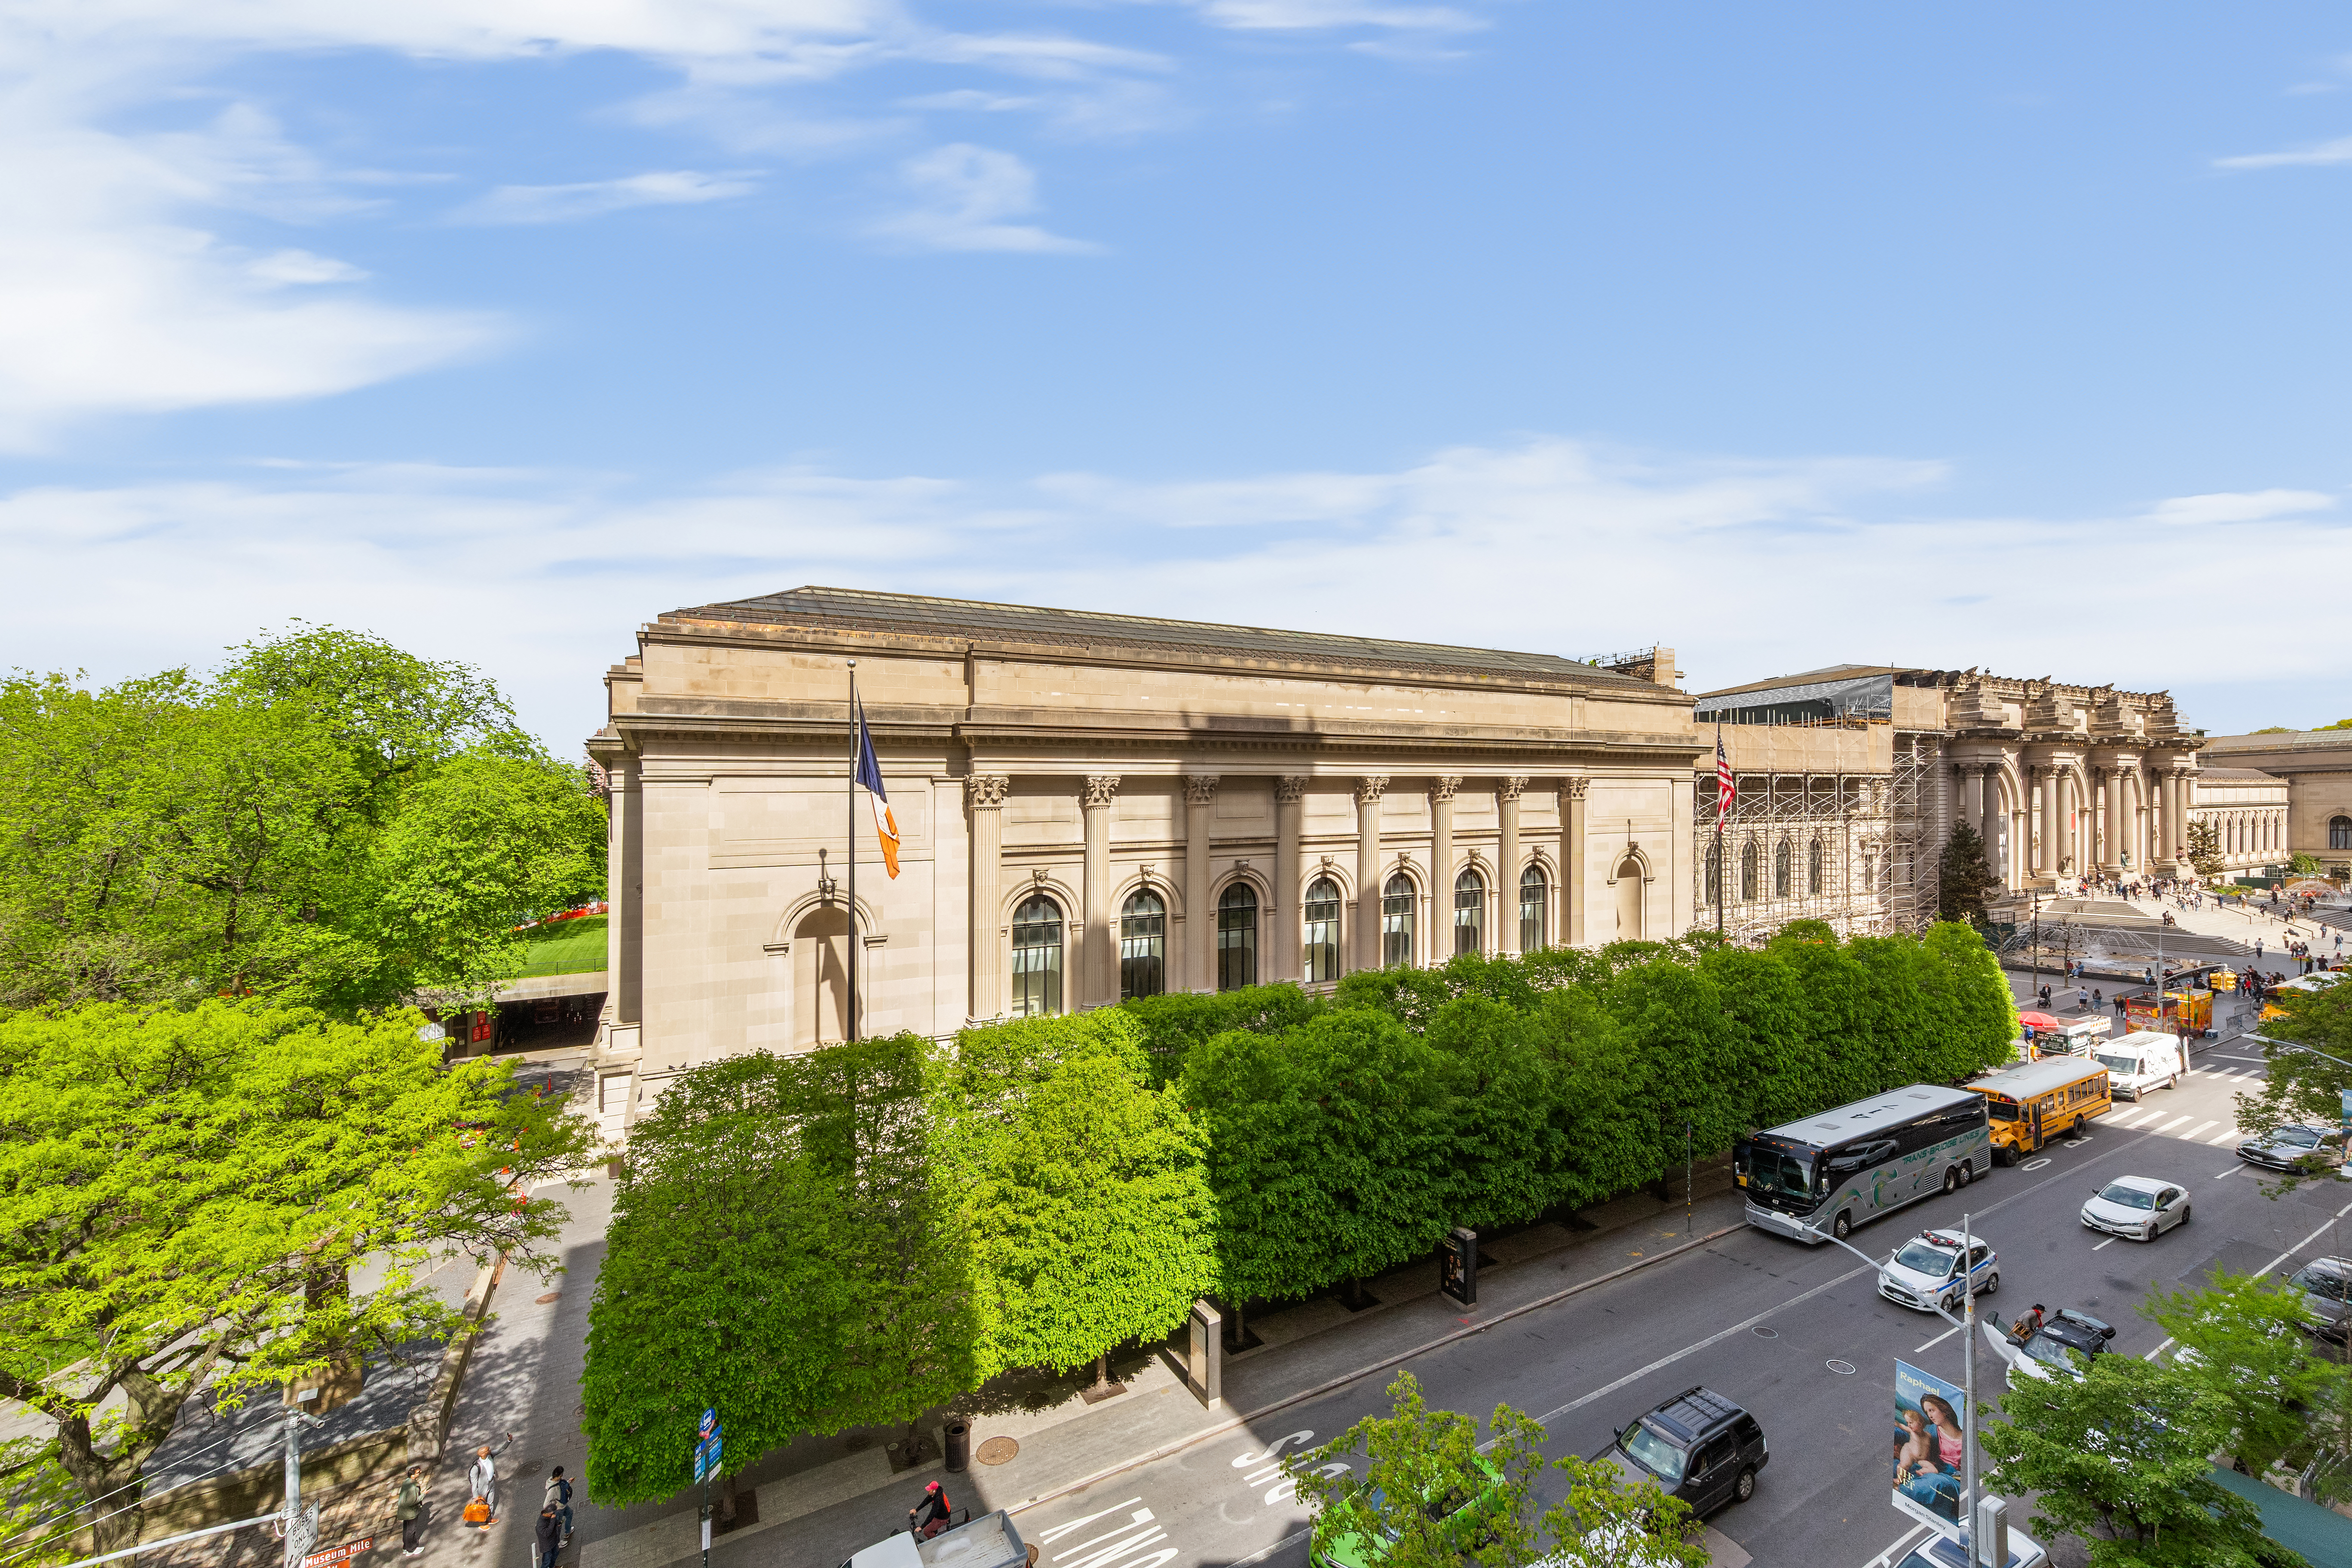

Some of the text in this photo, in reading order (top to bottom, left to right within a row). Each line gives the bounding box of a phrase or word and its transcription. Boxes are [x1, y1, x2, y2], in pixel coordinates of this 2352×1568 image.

[1960, 1130, 1980, 1144] LINES
[1900, 1371, 1940, 1396] Raphael
[695, 1453, 701, 1462] M2
[696, 1445, 701, 1455] M1
[1897, 1474, 1915, 1490] MET
[1898, 1466, 1914, 1481] THE
[293, 1509, 313, 1536] BUSES
[1905, 1502, 1946, 1530] Morgan Stanley
[294, 1525, 310, 1548] ONLY
[306, 1541, 370, 1568] Museum Mile
